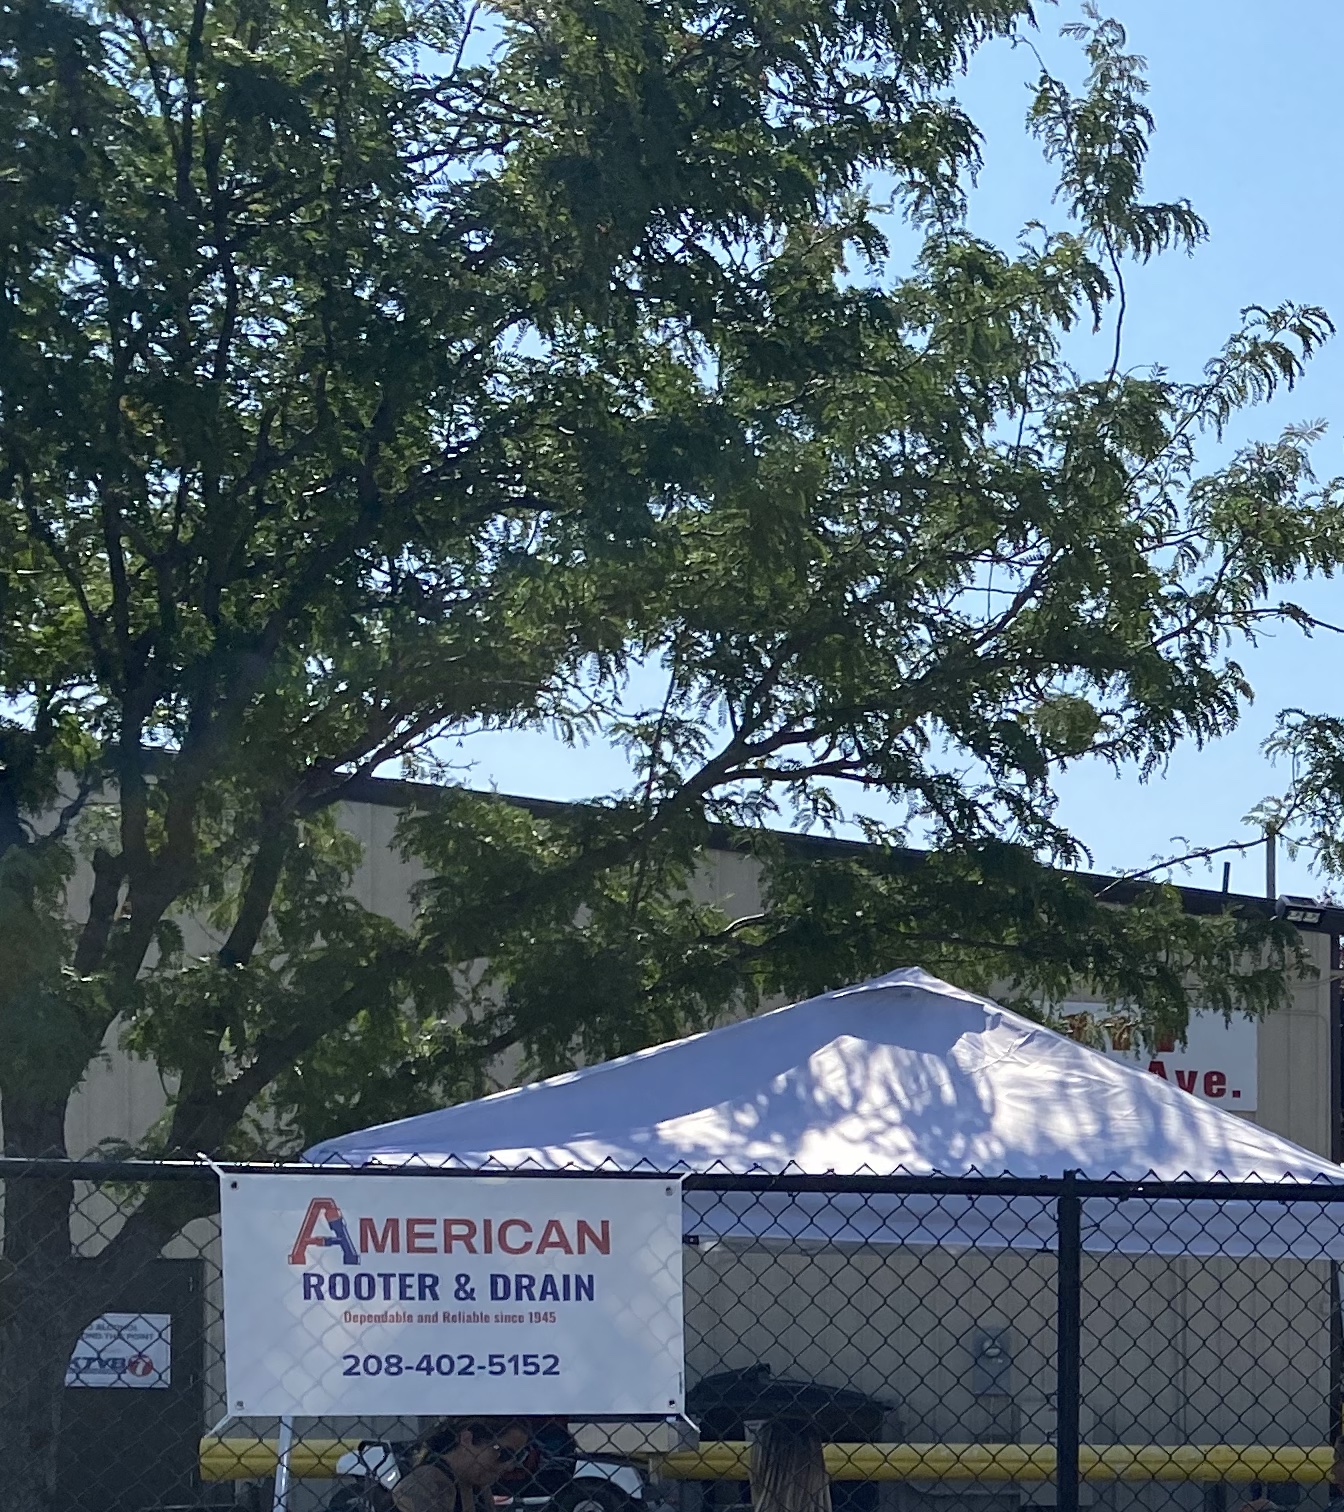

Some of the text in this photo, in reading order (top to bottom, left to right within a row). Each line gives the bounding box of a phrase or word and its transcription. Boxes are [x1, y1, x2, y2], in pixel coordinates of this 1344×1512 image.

[288, 1197, 611, 1266] AMERICAN
[303, 1272, 595, 1301] ROOTER & DRAIN
[343, 1310, 556, 1325] Dependable and Reliable since 1945
[342, 1354, 561, 1377] 208-402-5152
